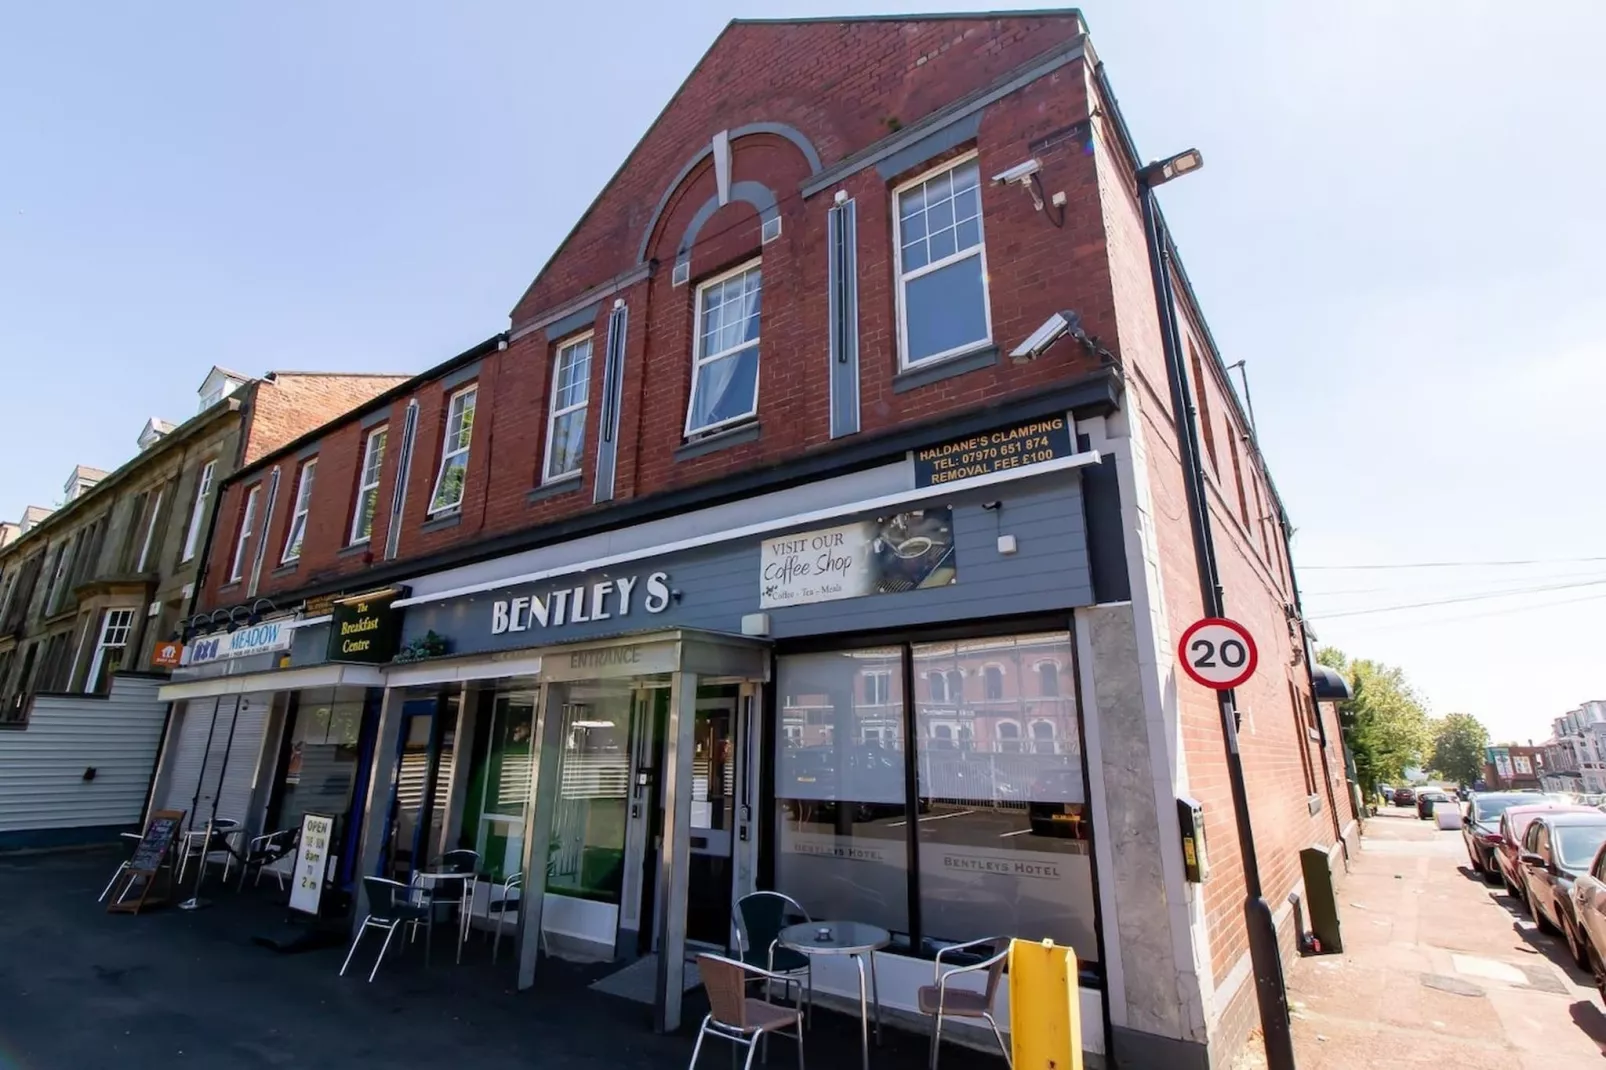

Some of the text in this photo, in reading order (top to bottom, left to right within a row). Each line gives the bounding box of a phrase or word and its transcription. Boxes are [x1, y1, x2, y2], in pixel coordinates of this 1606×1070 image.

[919, 418, 1063, 461] HALDANE'S CLAMPING
[933, 436, 1049, 471] TEL: 07970 651 874
[931, 449, 1053, 484] REMOVAL FEE £100
[772, 533, 844, 556] VISIT OUR
[764, 548, 852, 586] Coffee Shop
[772, 589, 794, 600] Coffee
[802, 587, 814, 597] Tea
[357, 602, 368, 613] The
[229, 623, 281, 650] MEADOW
[341, 617, 378, 635] Breakfast
[342, 639, 370, 653] Centre
[570, 646, 641, 669] ENTRANCE
[1191, 639, 1246, 668] 20
[307, 820, 328, 834] OPEN
[944, 857, 1060, 876] BENTLEYS HOTEL
